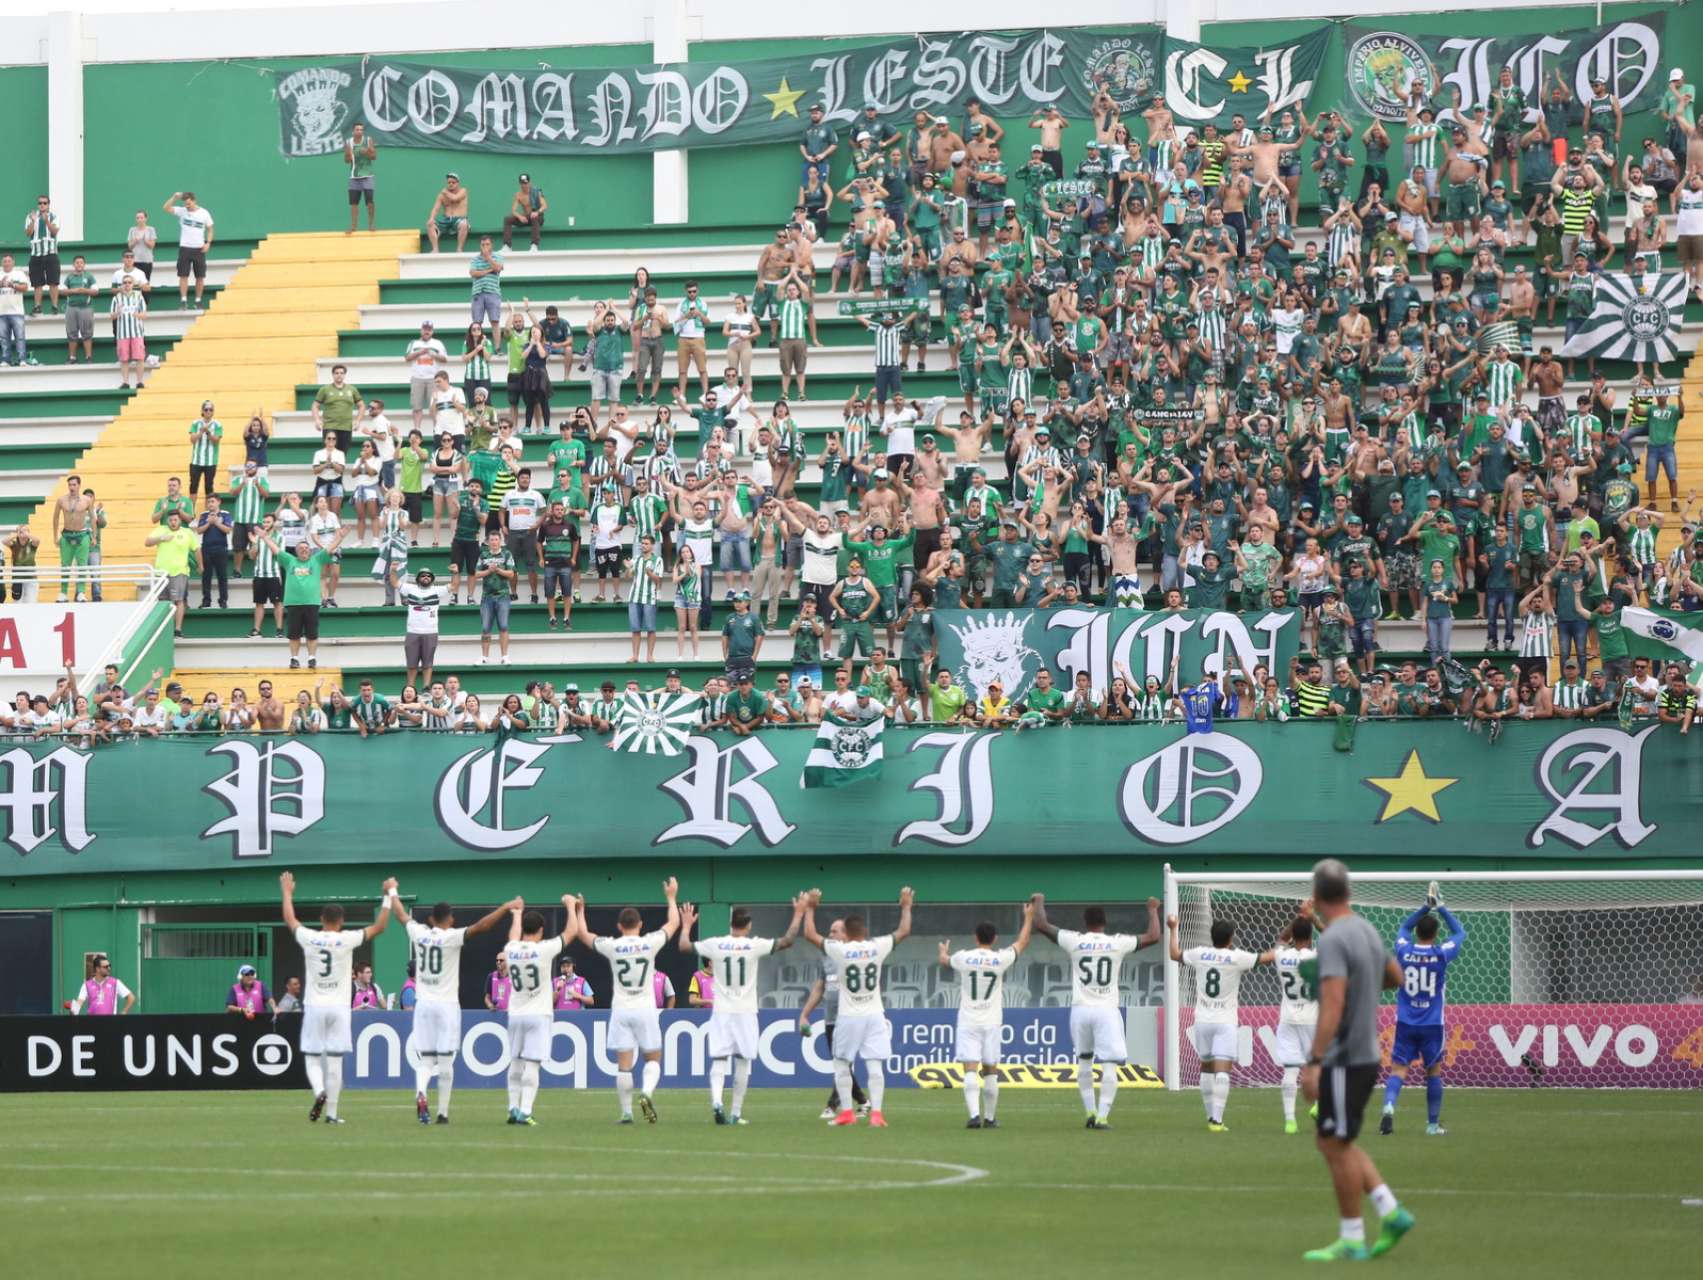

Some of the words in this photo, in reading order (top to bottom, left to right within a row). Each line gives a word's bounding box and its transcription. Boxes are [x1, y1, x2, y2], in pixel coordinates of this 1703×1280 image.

[278, 68, 352, 99] COMANDO
[361, 65, 749, 146] COMANDO
[809, 33, 1068, 122] LESTE
[1165, 48, 1229, 120] C
[1254, 44, 1314, 121] L
[290, 130, 347, 156] LESTE
[1632, 312, 1660, 325] CFC
[53, 612, 76, 668] 1
[616, 943, 651, 954] CAIXA
[1078, 941, 1113, 950] CAIXA
[1200, 952, 1233, 963] CAIXA
[1403, 952, 1439, 963] CAIXA
[318, 949, 332, 977] 3
[510, 962, 540, 993] 83
[616, 957, 650, 988] 27
[723, 955, 746, 987] 11
[845, 962, 878, 994] 88
[1078, 955, 1113, 987] 50
[1280, 958, 1298, 967] CAI
[968, 970, 998, 1001] 17
[1205, 967, 1221, 999] 8
[1404, 965, 1437, 998] 84
[903, 1023, 1015, 1045] remo
[1023, 1018, 1056, 1045] da
[1488, 1024, 1659, 1068] VIVO
[27, 1035, 97, 1077] DE
[123, 1033, 240, 1077] UNS
[886, 1046, 959, 1074] amíli
